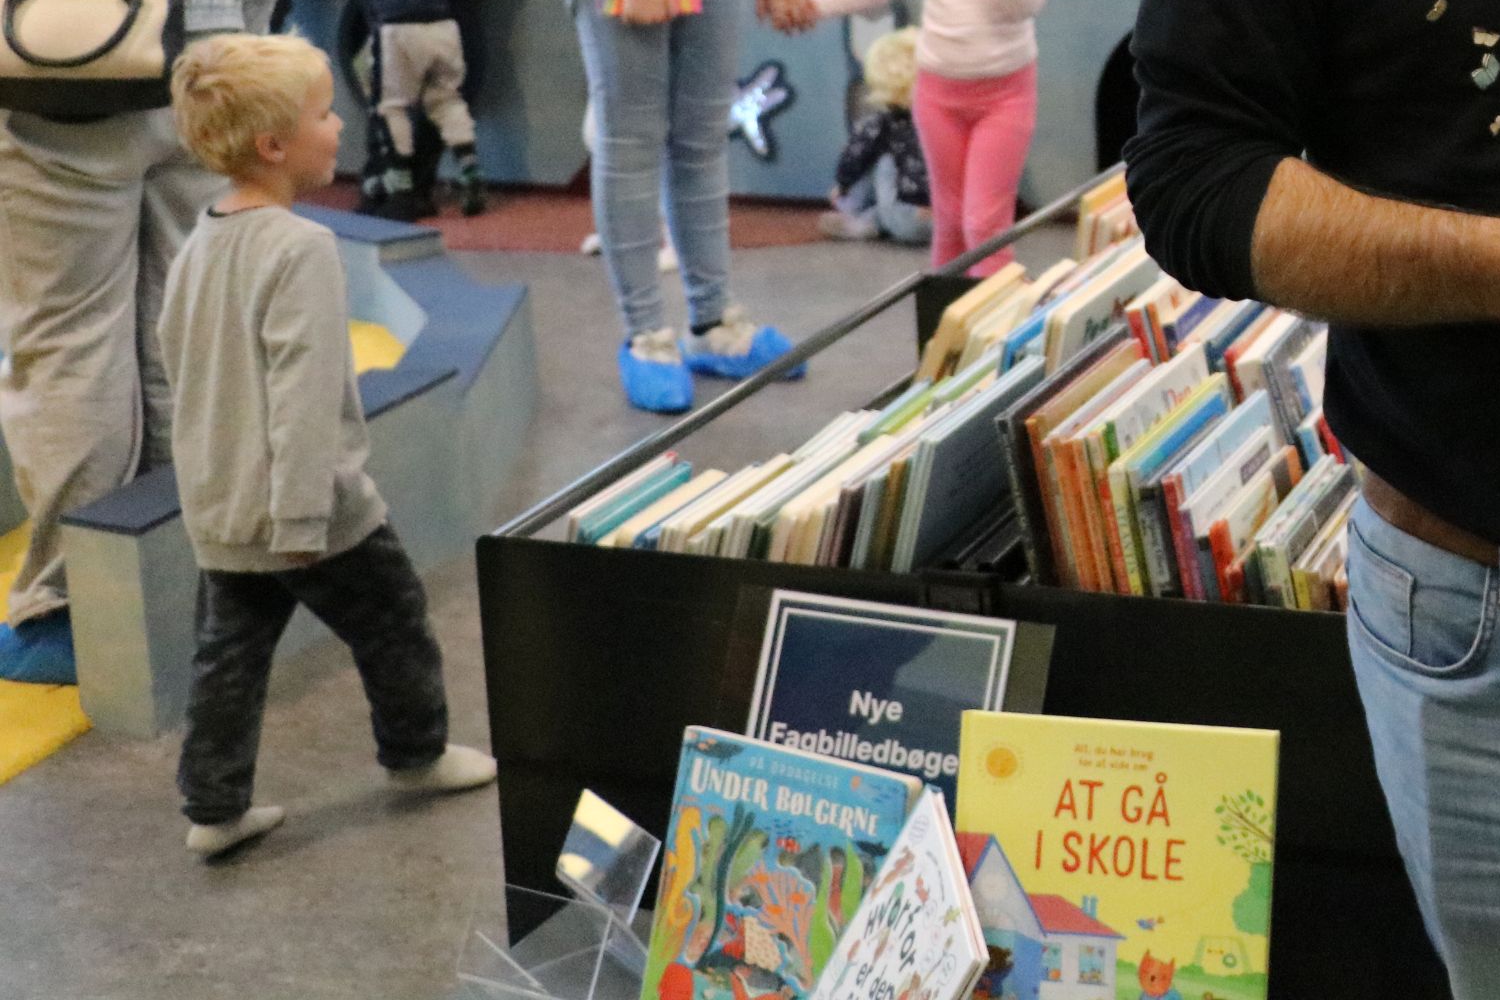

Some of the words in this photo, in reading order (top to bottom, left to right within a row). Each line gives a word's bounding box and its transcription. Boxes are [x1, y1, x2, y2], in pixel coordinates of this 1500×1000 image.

[849, 689, 903, 725] Nye
[769, 721, 960, 778] Fagbilledbøge
[690, 757, 769, 811] UNDER
[776, 785, 879, 837] BØLGERNE
[1053, 778, 1105, 821] AT
[1120, 771, 1170, 828] GÅ
[1035, 829, 1043, 871] I
[1061, 830, 1187, 882] SKOLE
